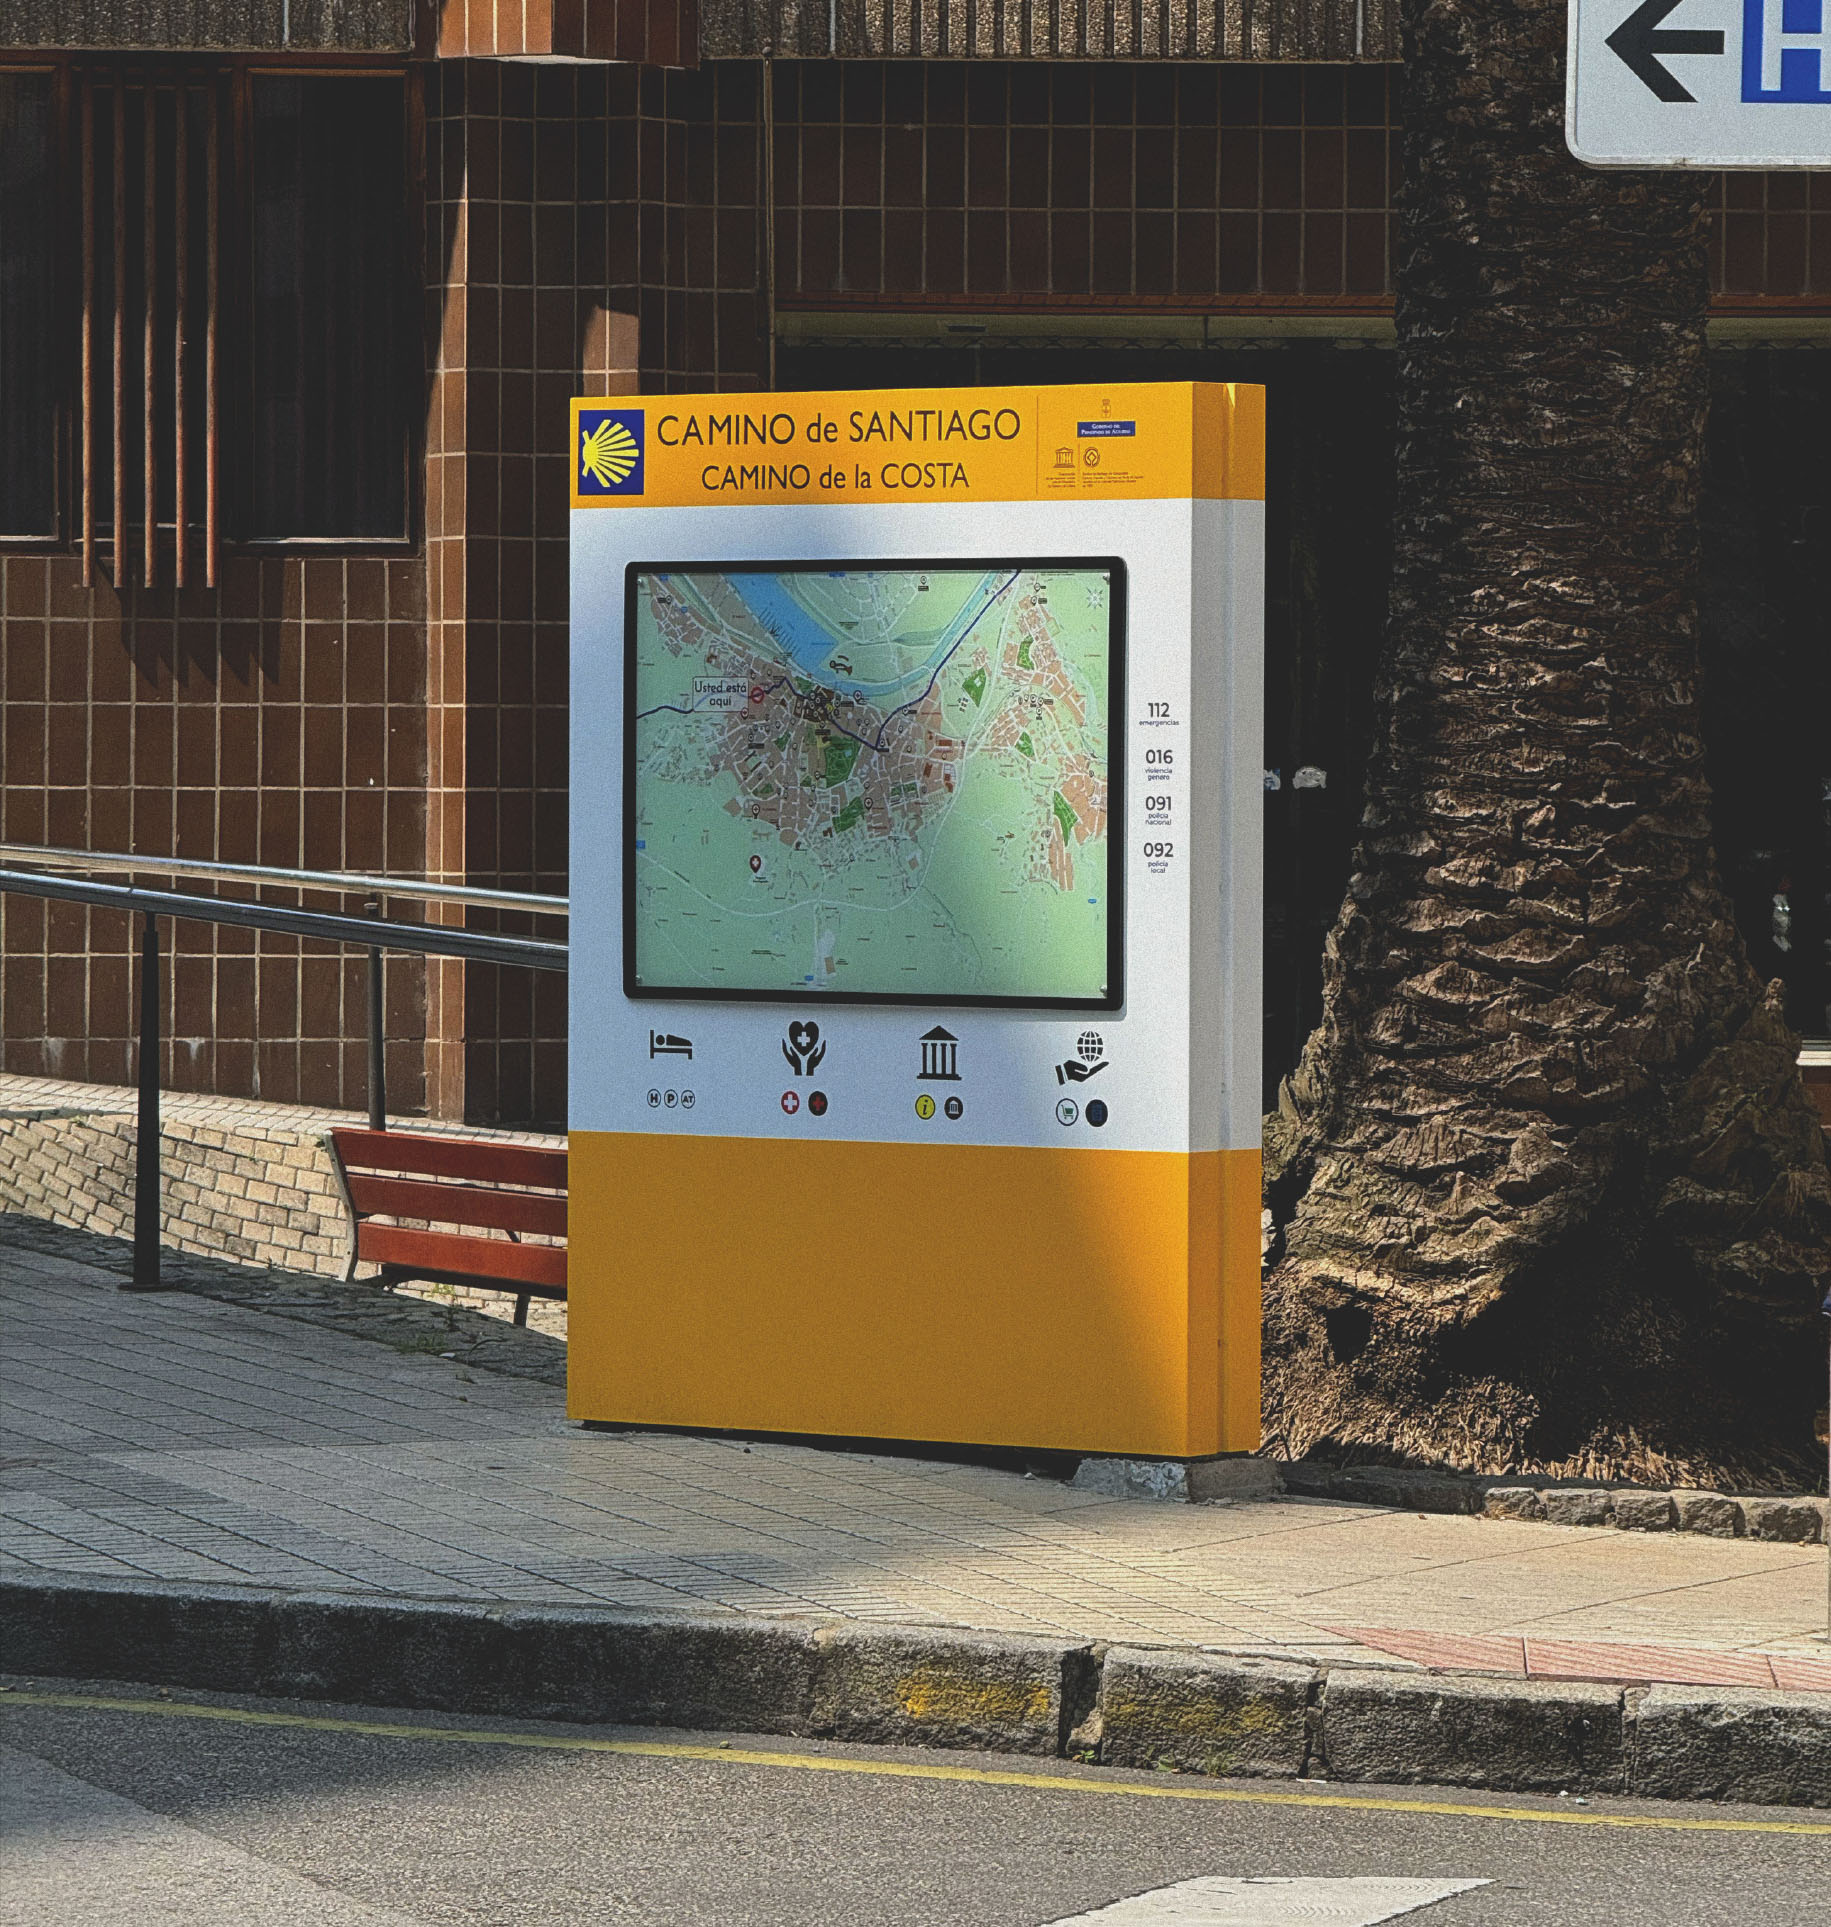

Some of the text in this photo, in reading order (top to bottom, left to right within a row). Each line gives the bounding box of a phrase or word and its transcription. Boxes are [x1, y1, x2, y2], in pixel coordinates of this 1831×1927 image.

[658, 408, 1020, 446] CAMINO de SANTIAGO
[702, 463, 969, 490] CAMINO de la COSTA
[694, 680, 747, 693] Usted está
[709, 696, 732, 708] aquí
[1148, 702, 1170, 718] 112
[1145, 749, 1173, 764] 016
[1145, 795, 1171, 811] 091
[1143, 842, 1174, 858] 092
[650, 1093, 694, 1104] H P AT
